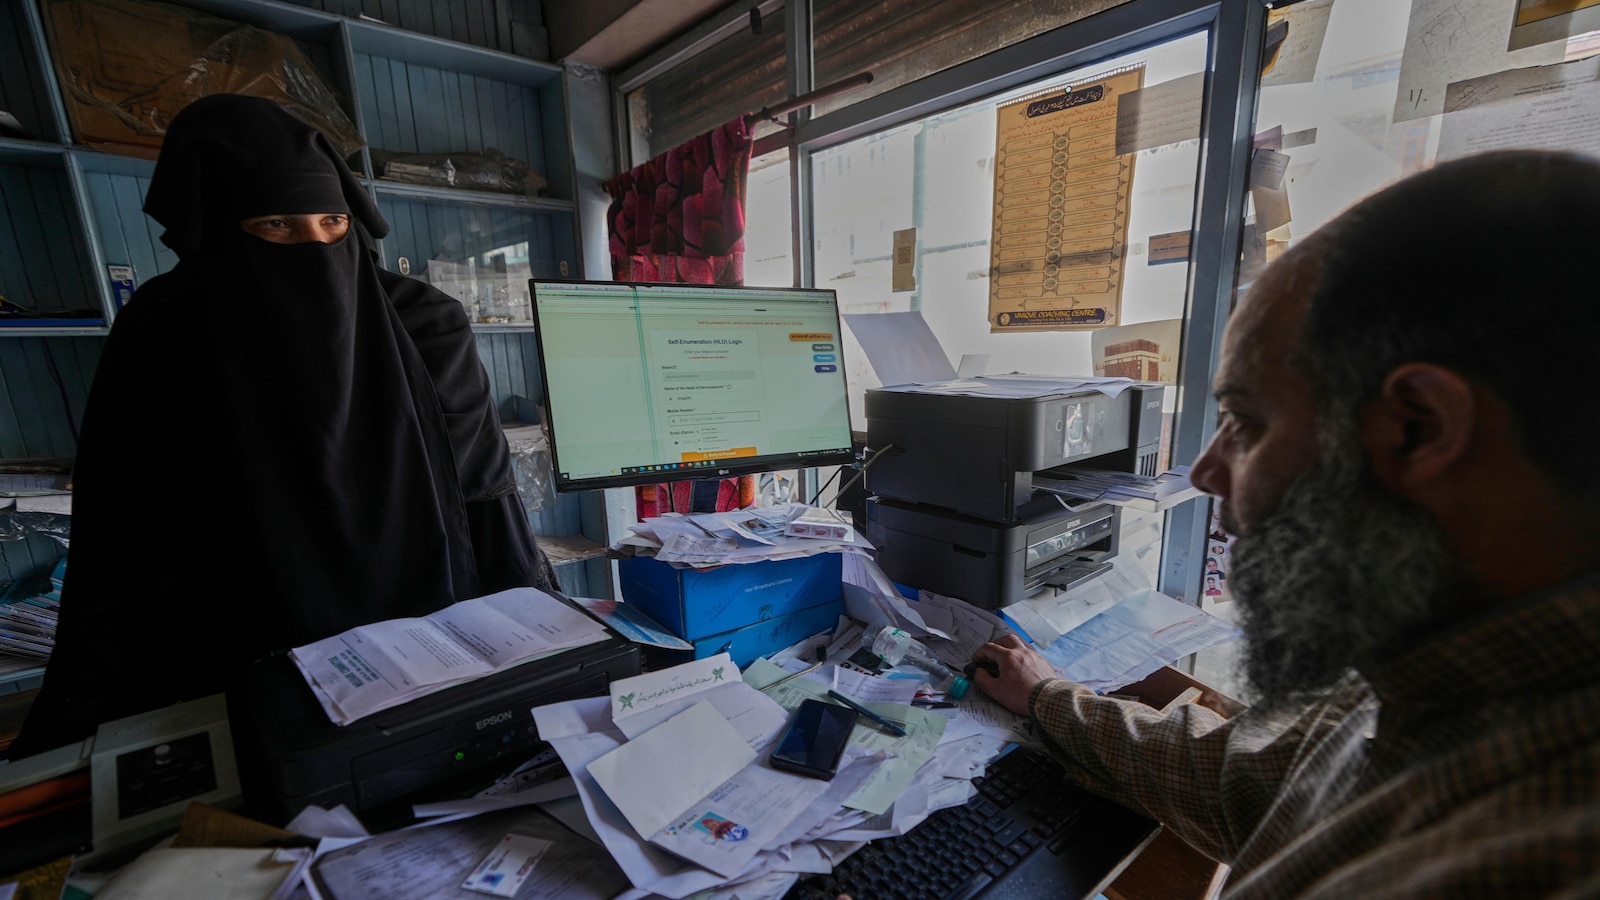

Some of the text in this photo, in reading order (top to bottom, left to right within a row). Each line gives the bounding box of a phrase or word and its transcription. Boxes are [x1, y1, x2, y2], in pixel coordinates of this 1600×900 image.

[1014, 311, 1036, 319] UNIQUE
[1038, 310, 1071, 318] COACHING
[1146, 400, 1161, 410] EPSON
[1066, 519, 1081, 530] EPSON
[476, 710, 512, 731] EPSON
